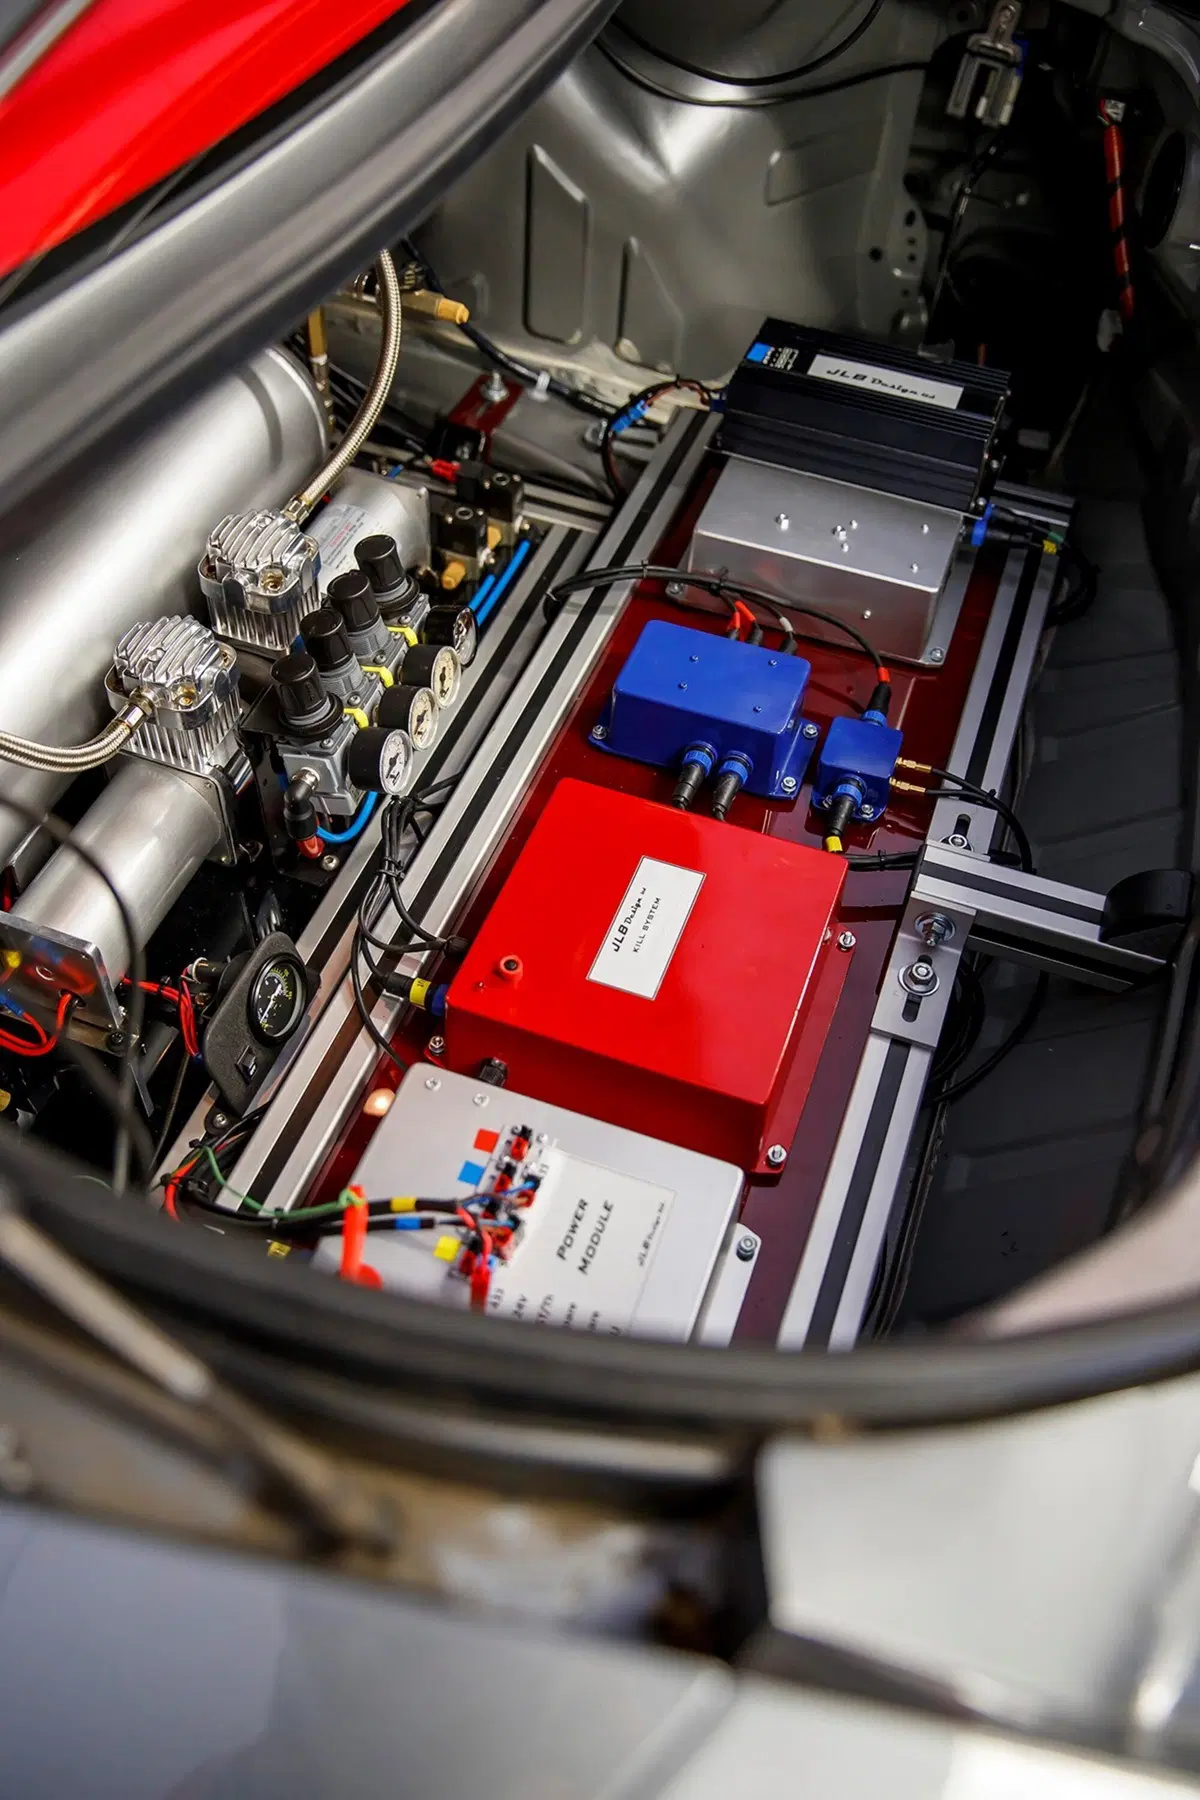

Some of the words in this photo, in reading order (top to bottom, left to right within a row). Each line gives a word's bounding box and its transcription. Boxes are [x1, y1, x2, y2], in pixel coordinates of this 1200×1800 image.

[826, 369, 868, 381] JLB
[871, 377, 918, 393] Design
[612, 924, 629, 952] JLB
[624, 897, 642, 925] Design
[633, 934, 646, 953] KILL
[642, 897, 661, 931] SYSTEM
[556, 1198, 589, 1261] POWER
[577, 1200, 614, 1276] MODULE
